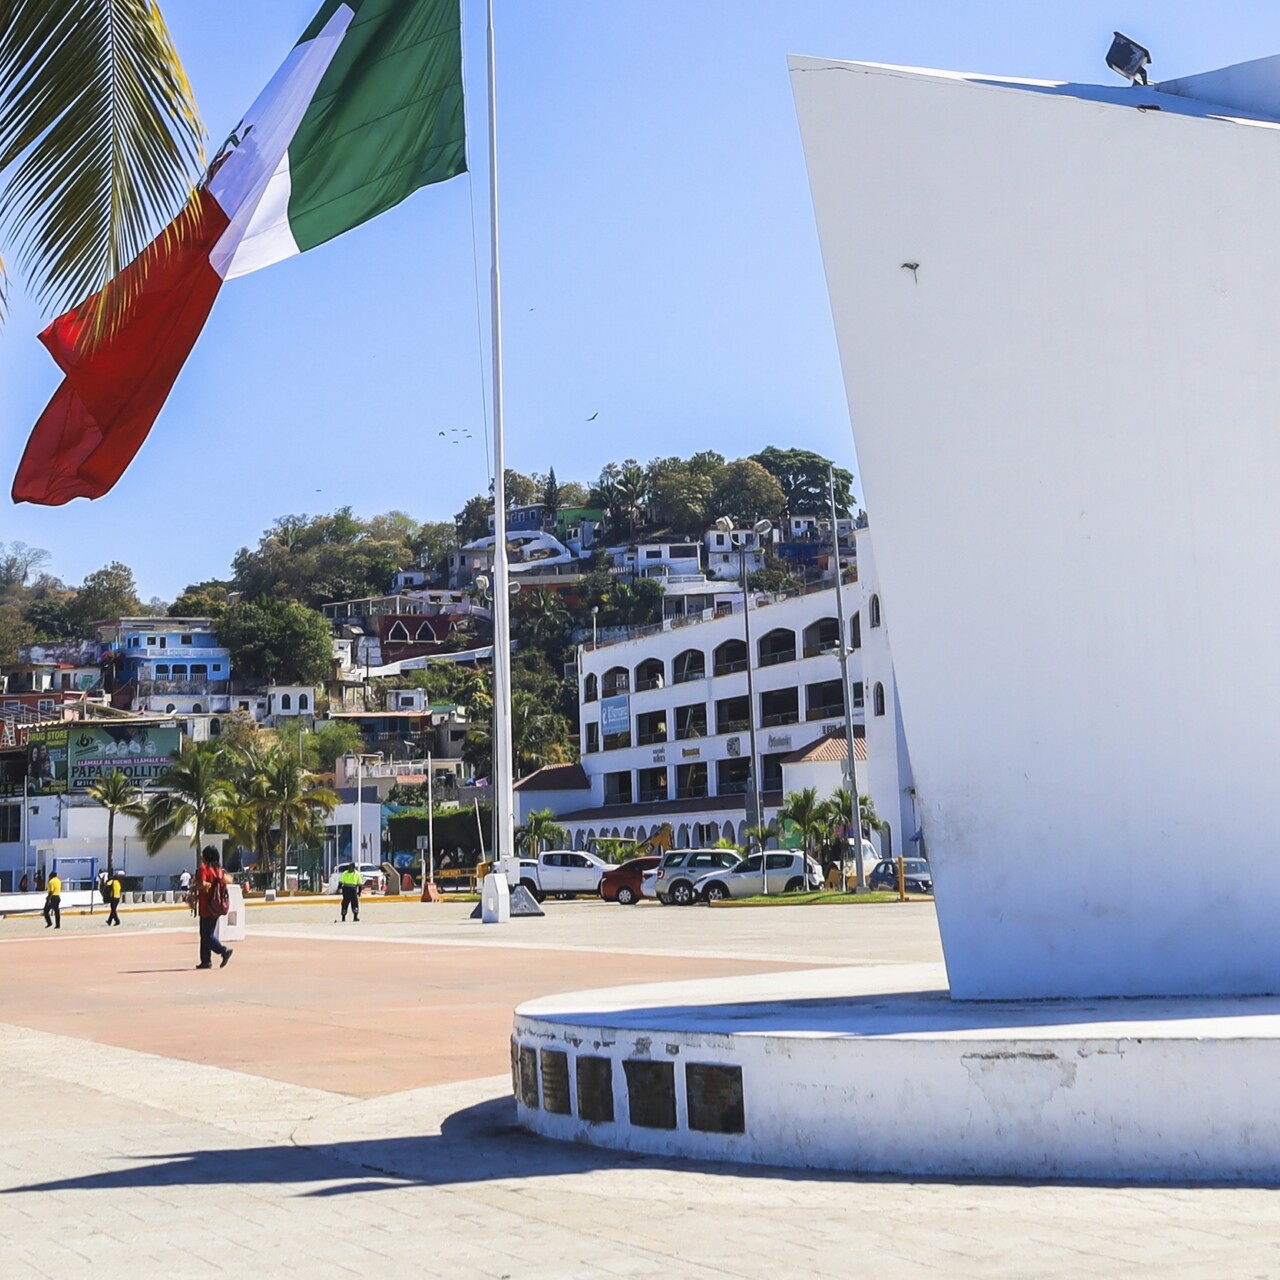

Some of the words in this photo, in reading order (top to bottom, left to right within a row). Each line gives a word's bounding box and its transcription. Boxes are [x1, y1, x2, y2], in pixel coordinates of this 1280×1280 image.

[28, 731, 45, 741] DRUG
[47, 729, 68, 739] STORE
[116, 765, 174, 778] POLLITO
